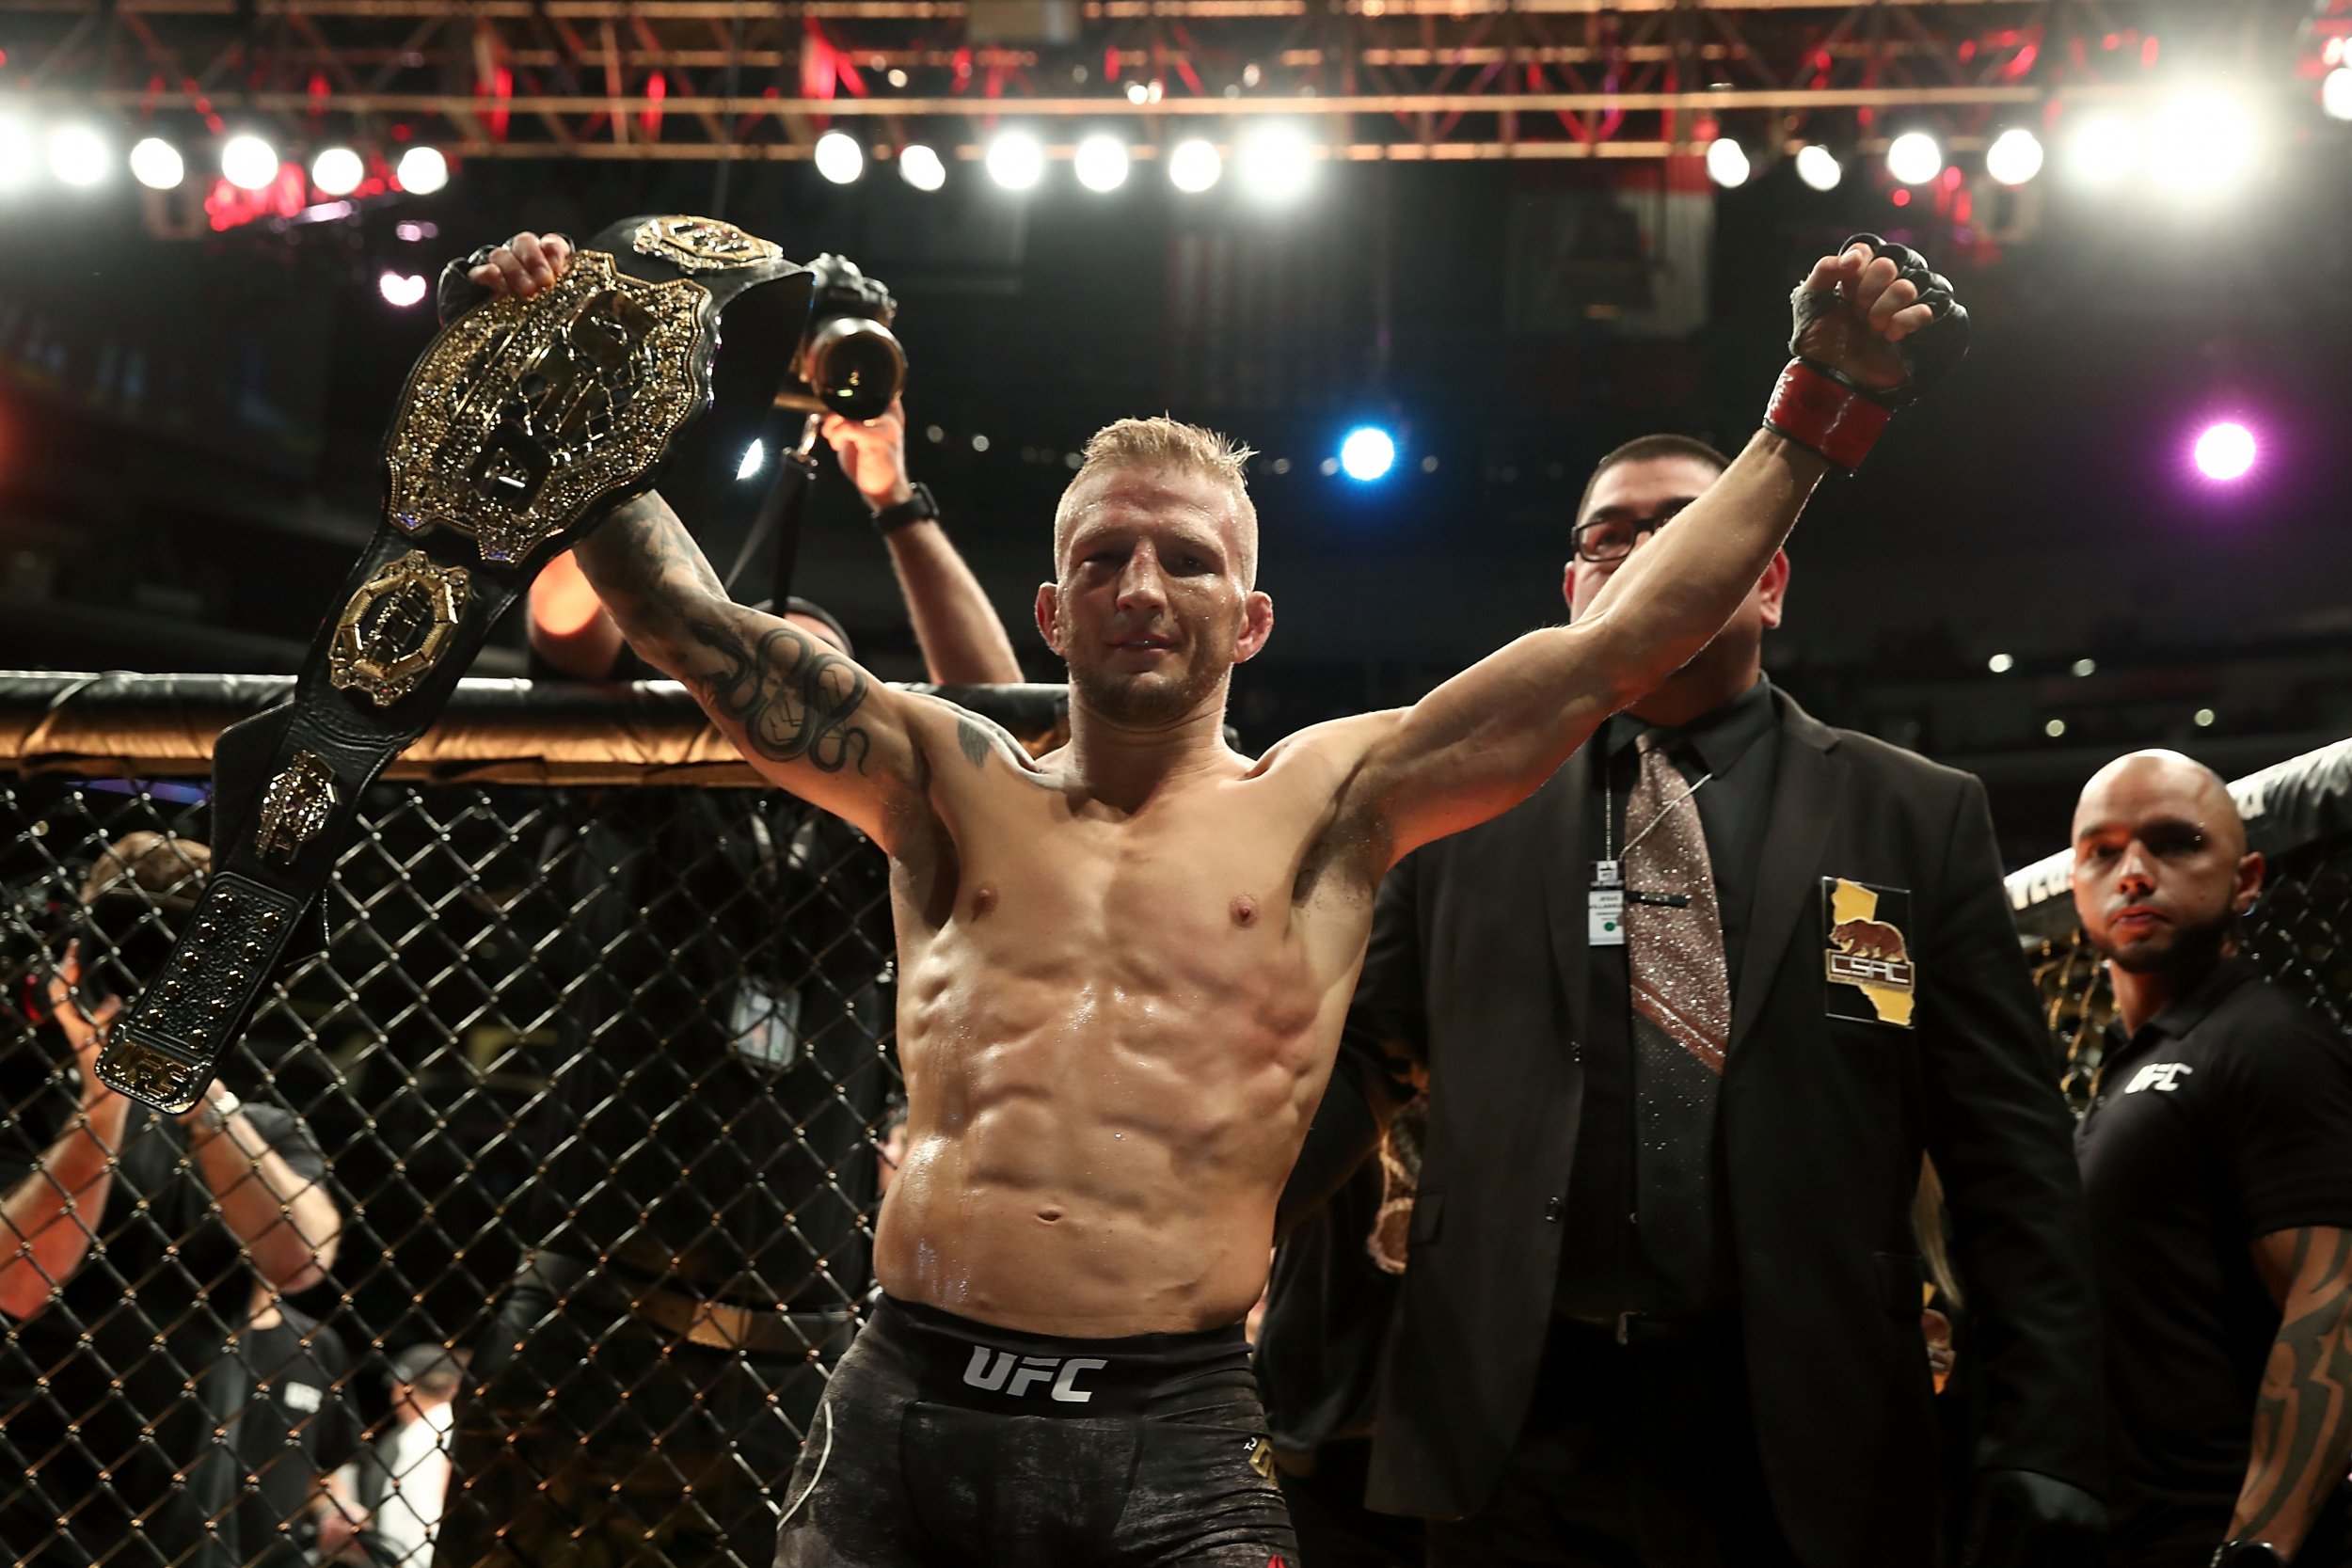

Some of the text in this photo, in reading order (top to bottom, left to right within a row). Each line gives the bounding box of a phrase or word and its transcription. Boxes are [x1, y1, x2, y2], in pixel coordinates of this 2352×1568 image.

[1831, 954, 1910, 984] CSAC
[103, 1039, 191, 1099] UFC
[2125, 1063, 2193, 1094] UFC
[962, 1345, 1108, 1402] UFC
